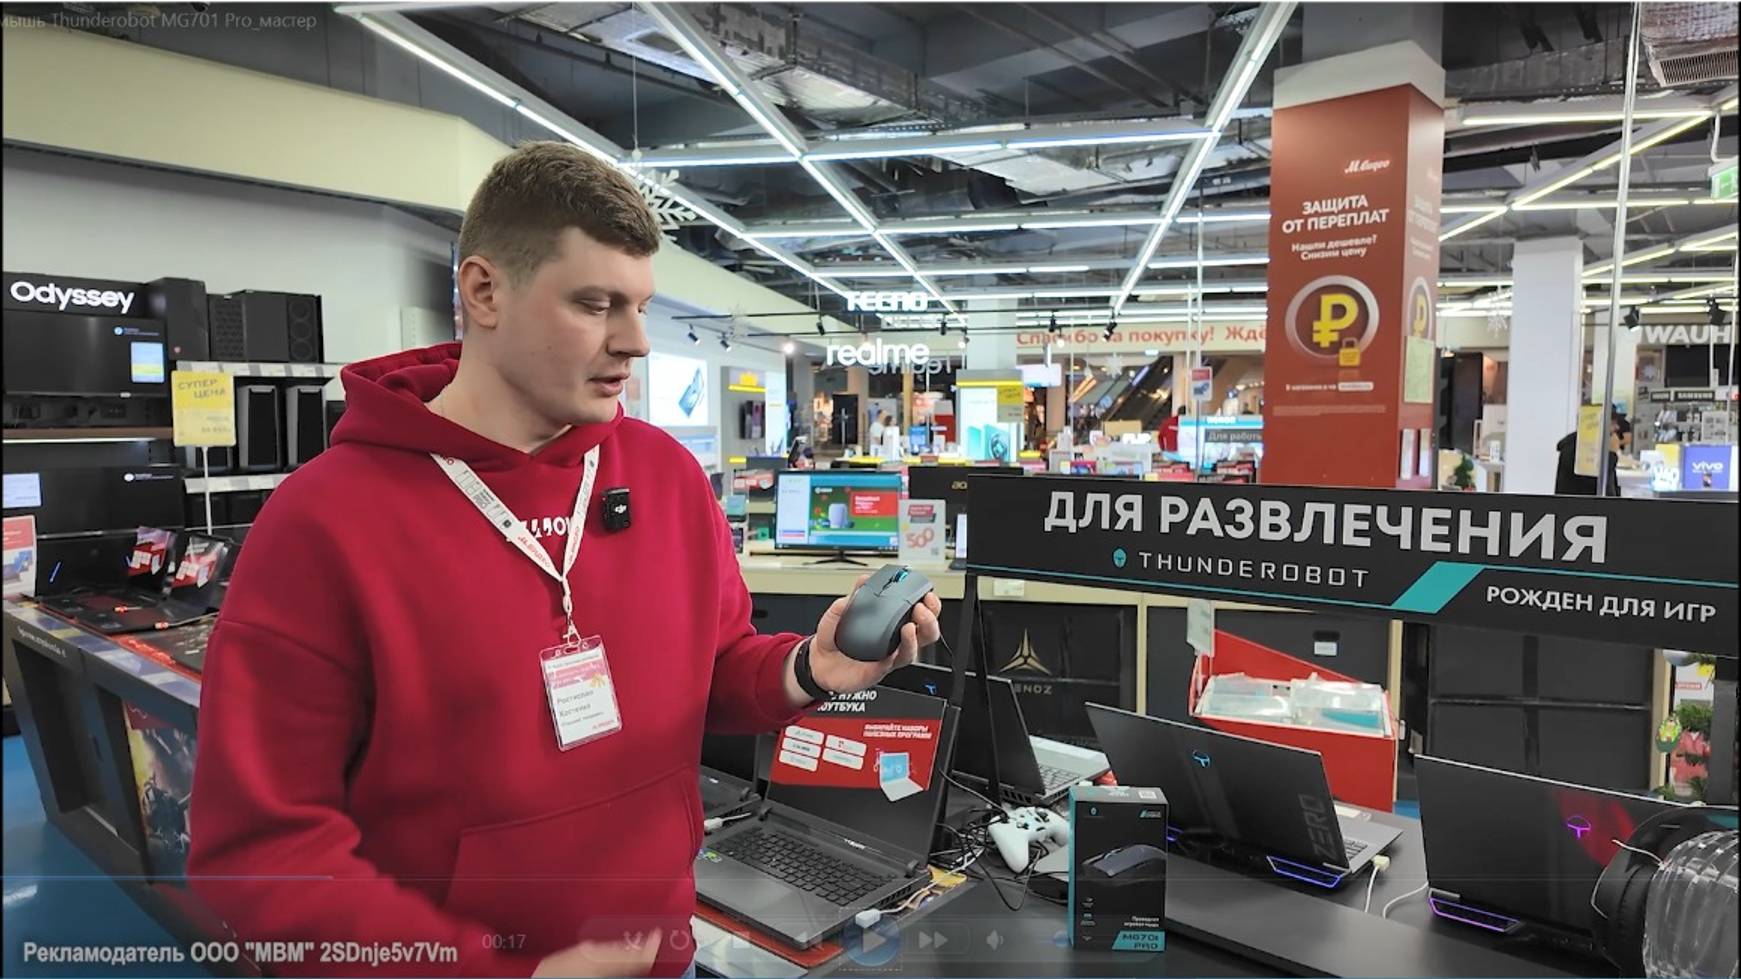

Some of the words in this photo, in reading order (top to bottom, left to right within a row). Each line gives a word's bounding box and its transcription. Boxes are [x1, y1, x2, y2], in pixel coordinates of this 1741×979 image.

[1302, 195, 1368, 215] ЗАЩИТА
[1282, 219, 1305, 234] ОТ
[1307, 209, 1390, 231] ПЕРЕПЛАТ
[1292, 240, 1326, 252] Нашли
[1327, 234, 1378, 249] дешевле?
[1300, 248, 1340, 261] Снизим
[1342, 247, 1367, 258] цену
[10, 280, 135, 314] Odyssey
[826, 338, 929, 366] realme
[1692, 461, 1723, 470] vivo
[1044, 491, 1143, 534] ДЛЯ
[1159, 495, 1608, 564] РАЗВЛЕЧЕНИЯ
[1139, 551, 1369, 588] THUNDEROBOT
[1486, 586, 1593, 612] РОЖДЕН
[1600, 596, 1655, 618] ДЛЯ
[1664, 601, 1716, 623] ИГР
[817, 702, 866, 713] ОУТБУКА
